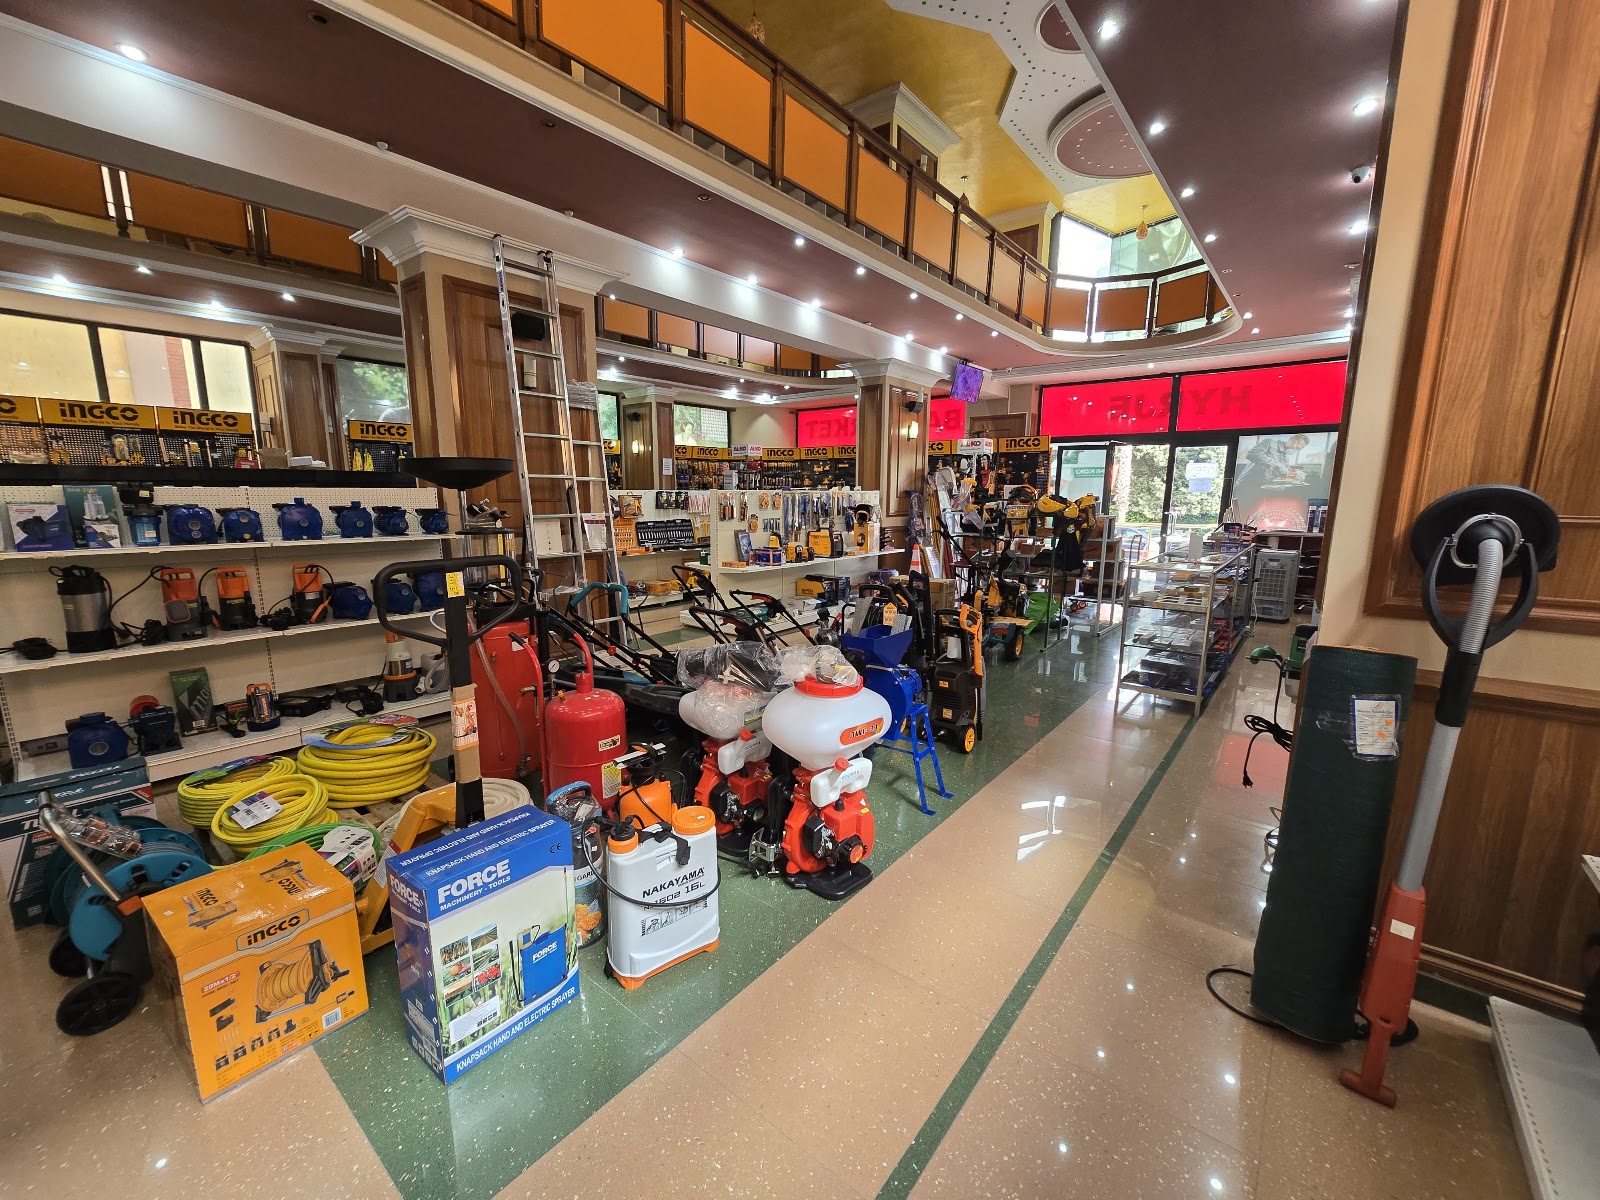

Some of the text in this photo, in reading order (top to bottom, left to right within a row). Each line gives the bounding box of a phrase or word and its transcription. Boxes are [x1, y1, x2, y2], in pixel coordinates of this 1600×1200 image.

[426, 818, 556, 877] KNAPSACK HAND AND ELECTRIC SPRAYER
[389, 873, 421, 907] FORCE
[438, 858, 511, 905] FORCE
[440, 887, 483, 912] MACHINERY
[488, 875, 511, 890] TOOLS
[642, 867, 704, 899] NAKAYAMA
[532, 941, 558, 962] FORCE
[456, 1042, 493, 1072] KNAPSACK
[493, 1030, 511, 1050] HAND
[510, 1022, 524, 1038] AND
[524, 1005, 552, 1027] ELECTRIC
[551, 986, 576, 1009] SPRAYER
